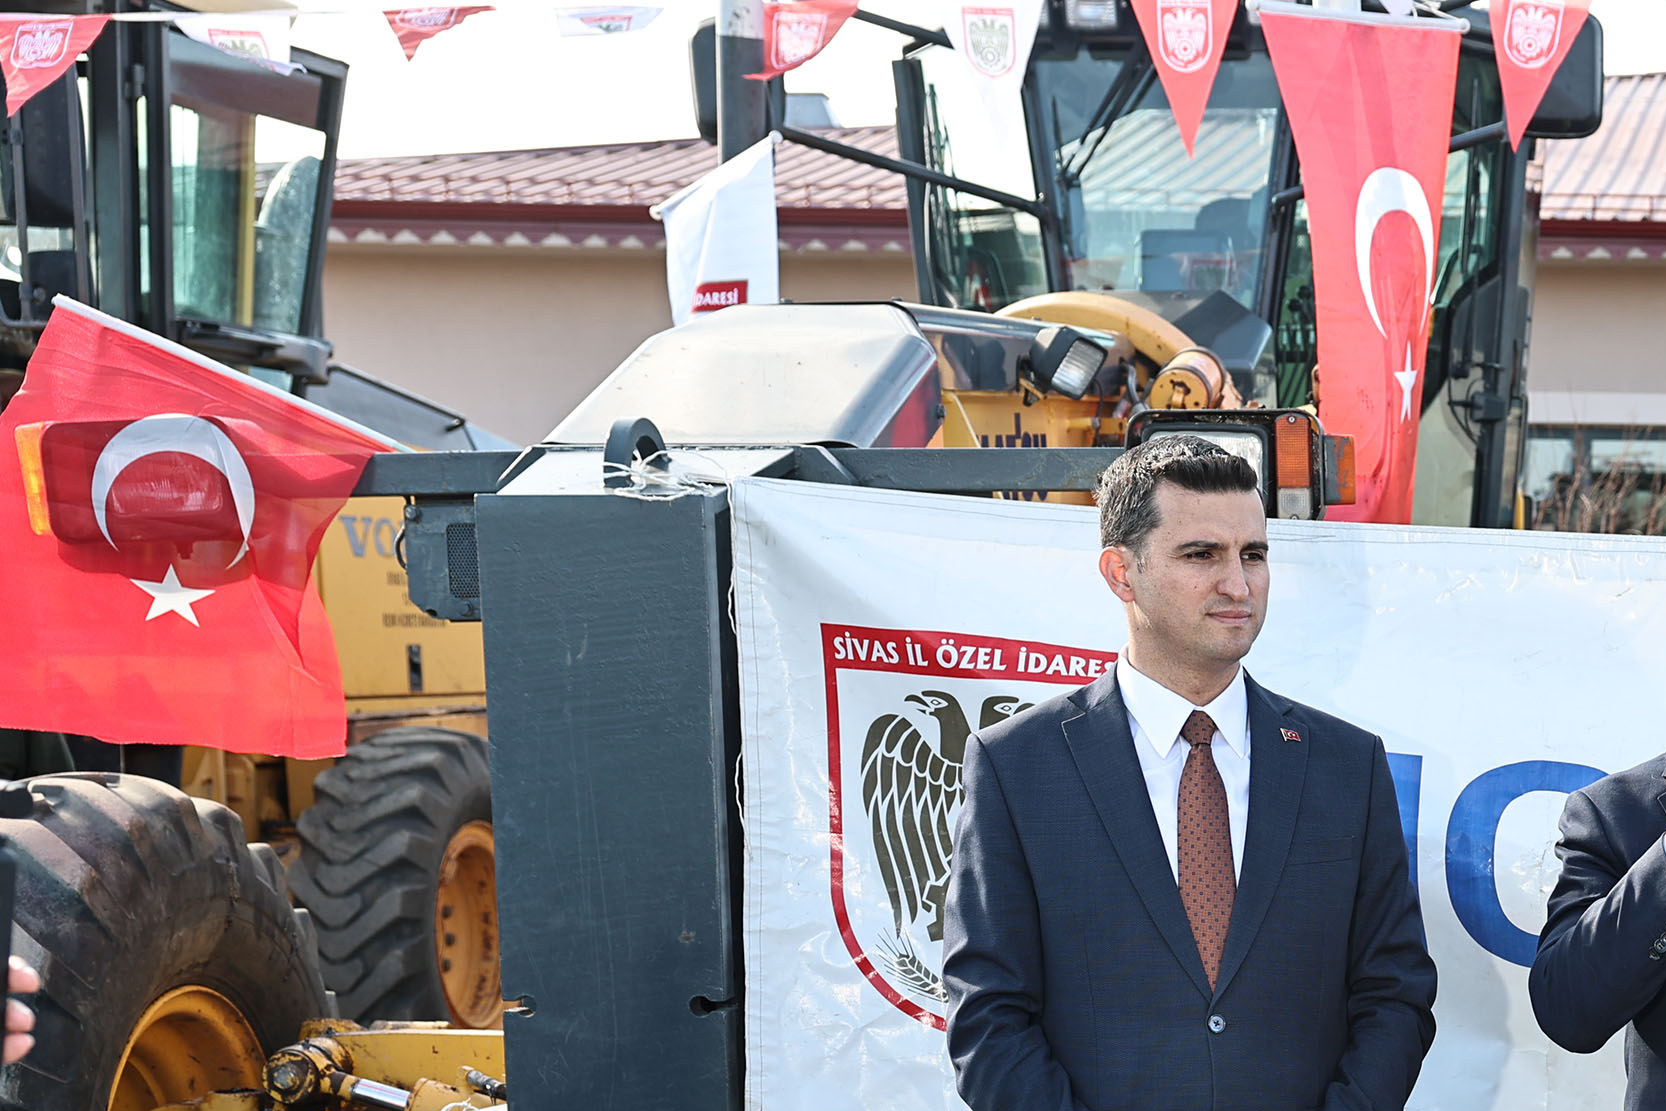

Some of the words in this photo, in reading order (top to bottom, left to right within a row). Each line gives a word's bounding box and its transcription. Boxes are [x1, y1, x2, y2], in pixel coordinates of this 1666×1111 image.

[694, 288, 739, 306] DARESİ
[833, 631, 900, 665] SİVAS
[905, 636, 929, 667] İL
[935, 638, 1007, 672] ÖZEL
[1016, 646, 1115, 678] İDARE
